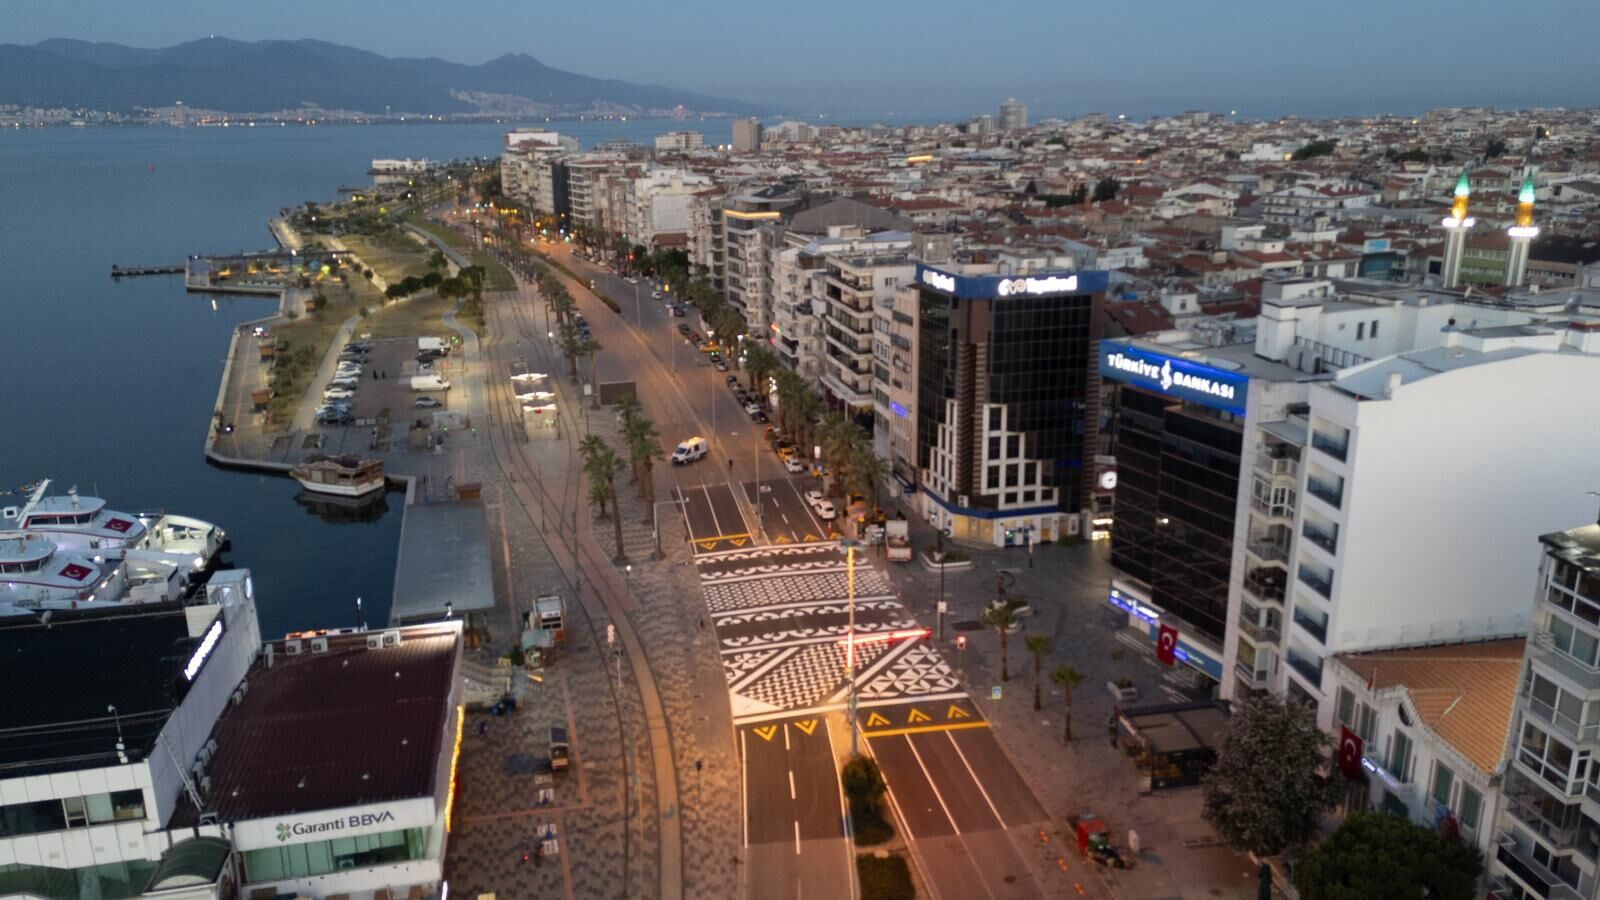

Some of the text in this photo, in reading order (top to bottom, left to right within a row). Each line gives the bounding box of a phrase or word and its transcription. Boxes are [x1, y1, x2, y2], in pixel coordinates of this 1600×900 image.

[1107, 353, 1234, 399] TÜRKİYE BANKASI
[292, 810, 395, 835] Garanti BBVA
